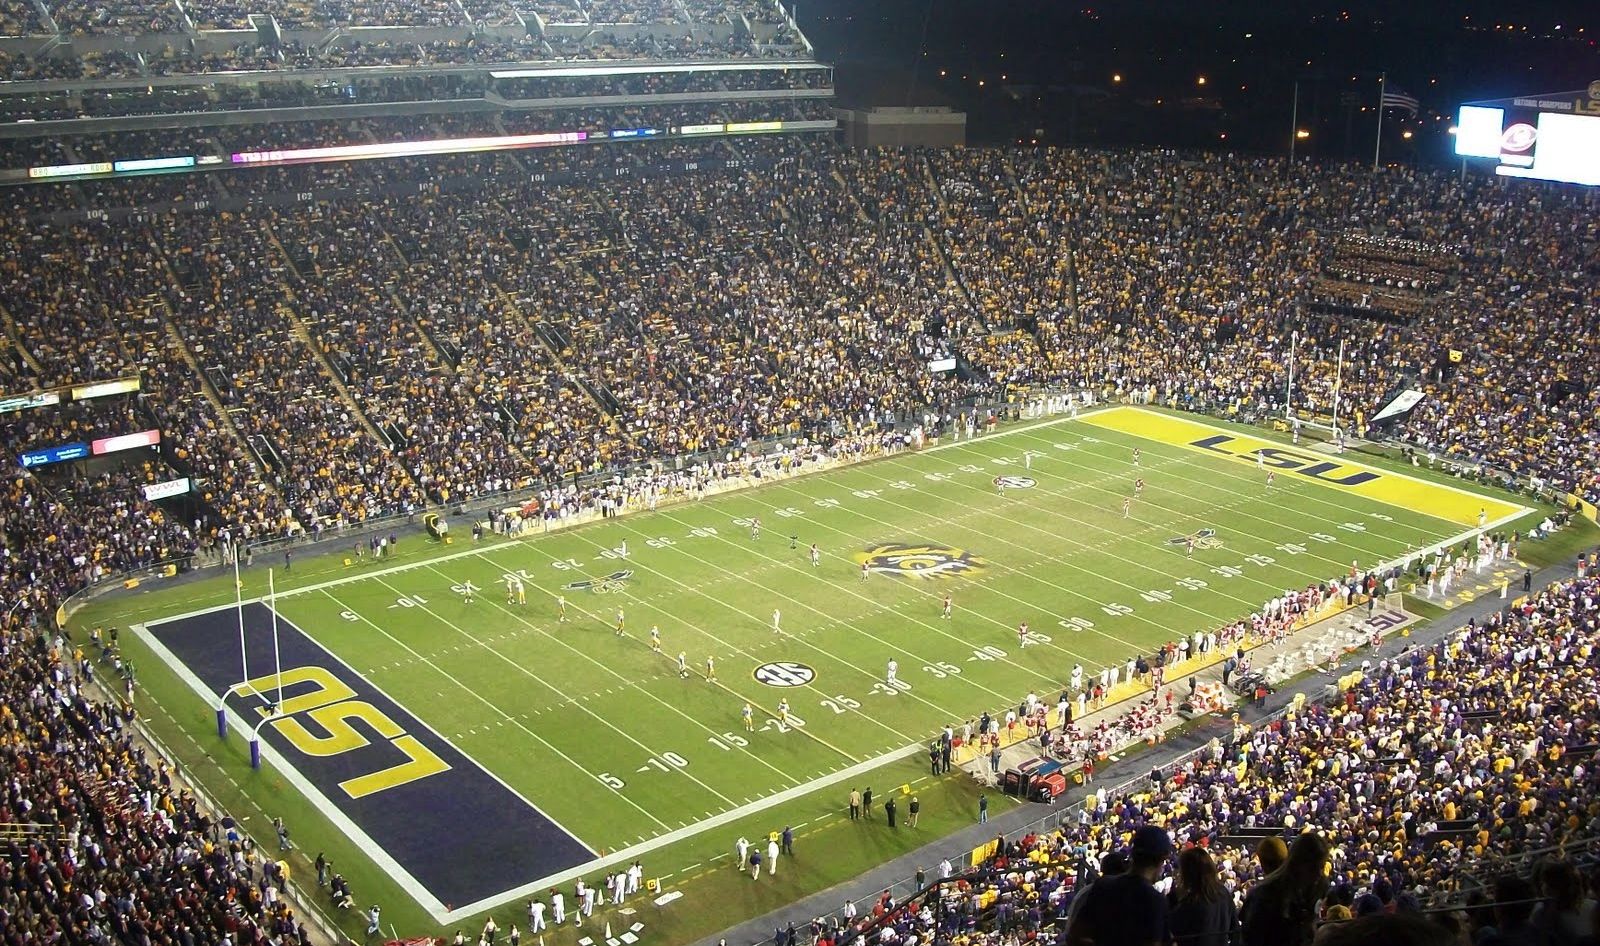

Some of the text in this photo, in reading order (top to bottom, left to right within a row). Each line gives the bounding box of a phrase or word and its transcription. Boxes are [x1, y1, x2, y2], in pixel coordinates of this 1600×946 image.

[531, 174, 545, 182] 104
[1189, 434, 1382, 486] LSU
[551, 559, 584, 571] 25
[1175, 577, 1208, 590] 35
[397, 594, 428, 608] 10
[1139, 589, 1172, 602] 40
[340, 611, 360, 621] 5
[1100, 602, 1133, 616] 45
[1058, 617, 1095, 632] 50
[1365, 610, 1408, 631] SU
[972, 645, 1008, 661] 40
[757, 662, 813, 686] SEC
[922, 661, 962, 679] 35
[873, 679, 912, 696] 30
[820, 694, 862, 714] 25
[765, 713, 806, 733] 20
[229, 665, 453, 800] LSU
[707, 731, 750, 751] 15
[647, 752, 690, 772] 10
[598, 772, 625, 789] 5
